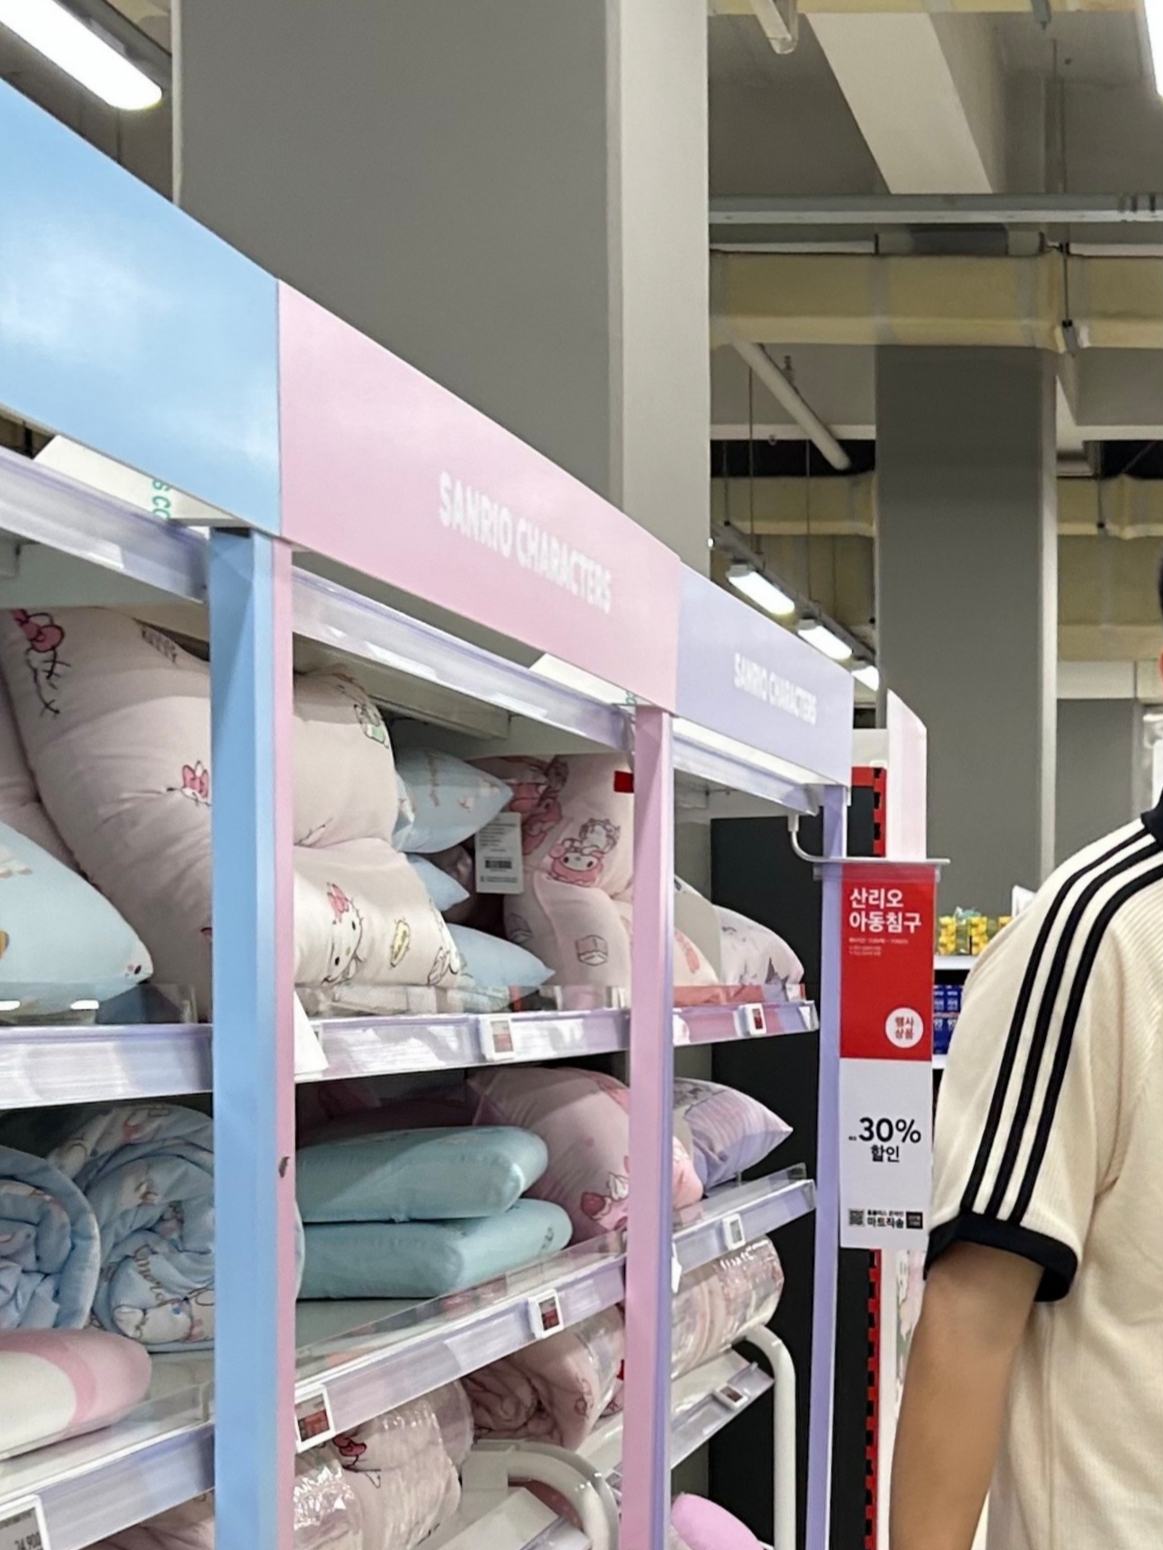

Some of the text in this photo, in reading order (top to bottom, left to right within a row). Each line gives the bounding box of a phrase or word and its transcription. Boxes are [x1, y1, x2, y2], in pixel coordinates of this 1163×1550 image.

[438, 470, 613, 615] SANRIO CHARACTERS
[734, 652, 818, 726] SANRIO CHARACTERS
[849, 887, 904, 910] 산리오
[848, 910, 922, 934] 아동침구
[858, 1116, 922, 1144] 30%
[870, 1144, 900, 1163] 할인
[867, 1216, 905, 1229] 마트직송
